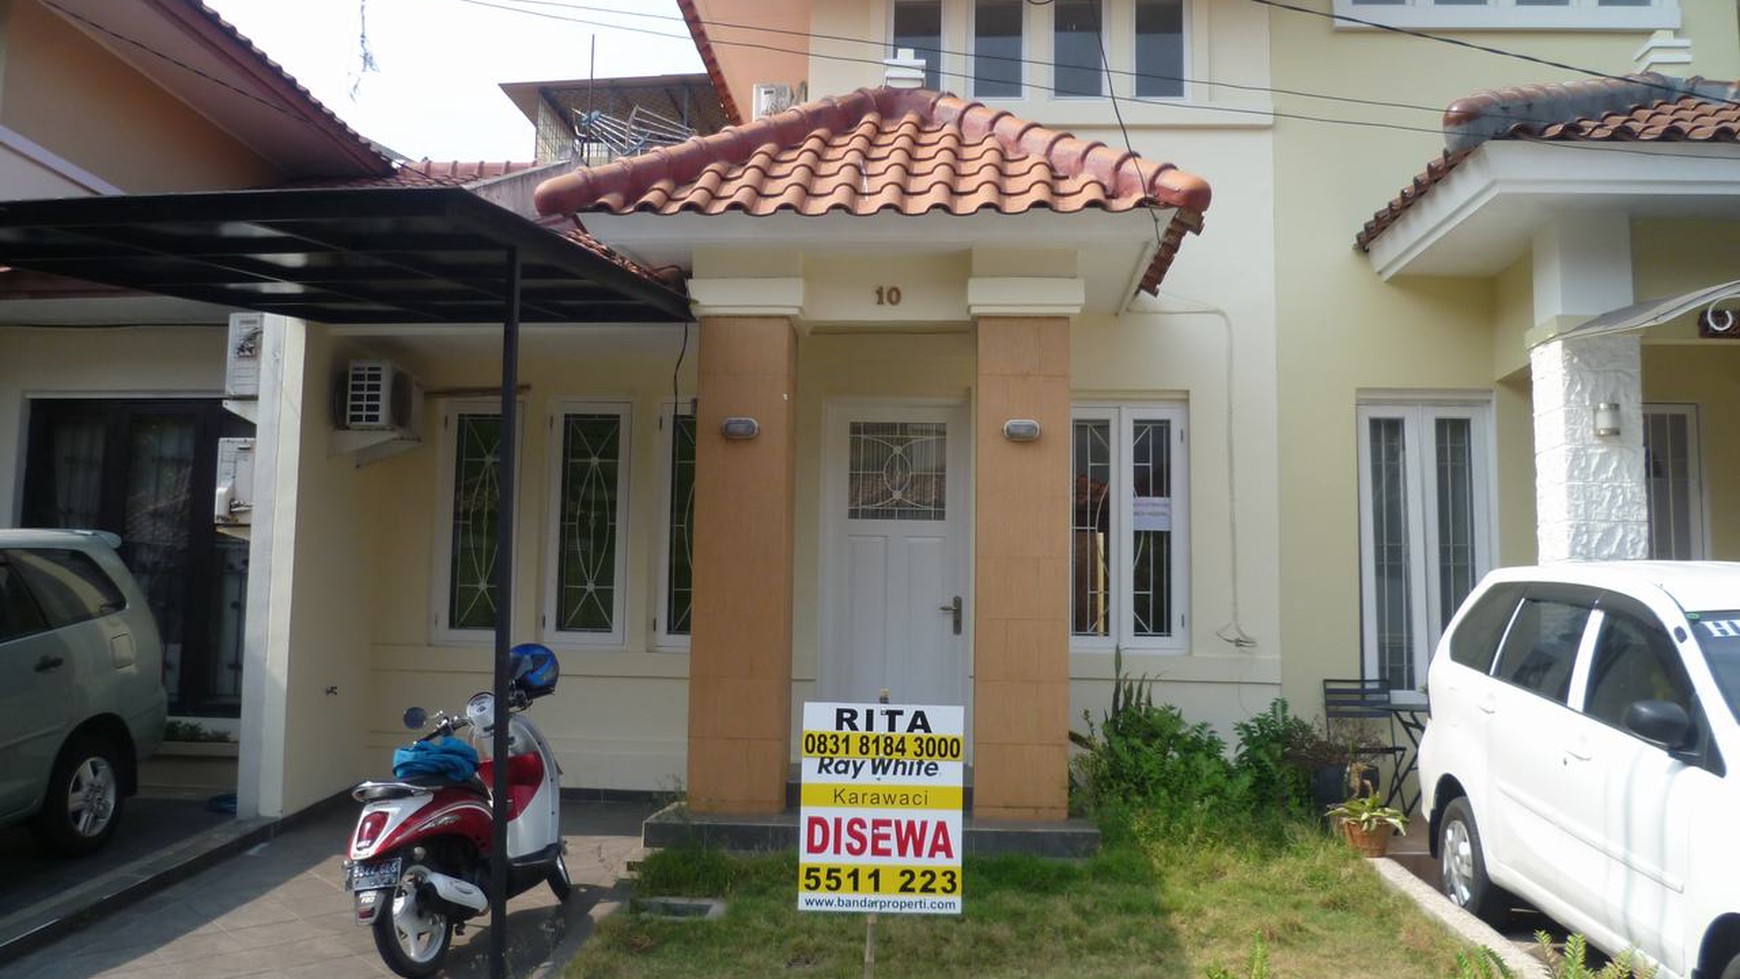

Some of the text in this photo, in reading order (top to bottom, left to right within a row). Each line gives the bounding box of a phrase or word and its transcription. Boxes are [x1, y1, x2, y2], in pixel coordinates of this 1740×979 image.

[875, 285, 902, 306] 10
[835, 708, 932, 734] RITA
[805, 734, 961, 758] 0831 8184 3000
[817, 756, 939, 779] Ray White
[833, 788, 928, 806] Karawaci
[806, 815, 954, 859] DISEWA
[804, 867, 957, 894] 5511 223
[805, 897, 956, 911] www.bandarproperti.com
